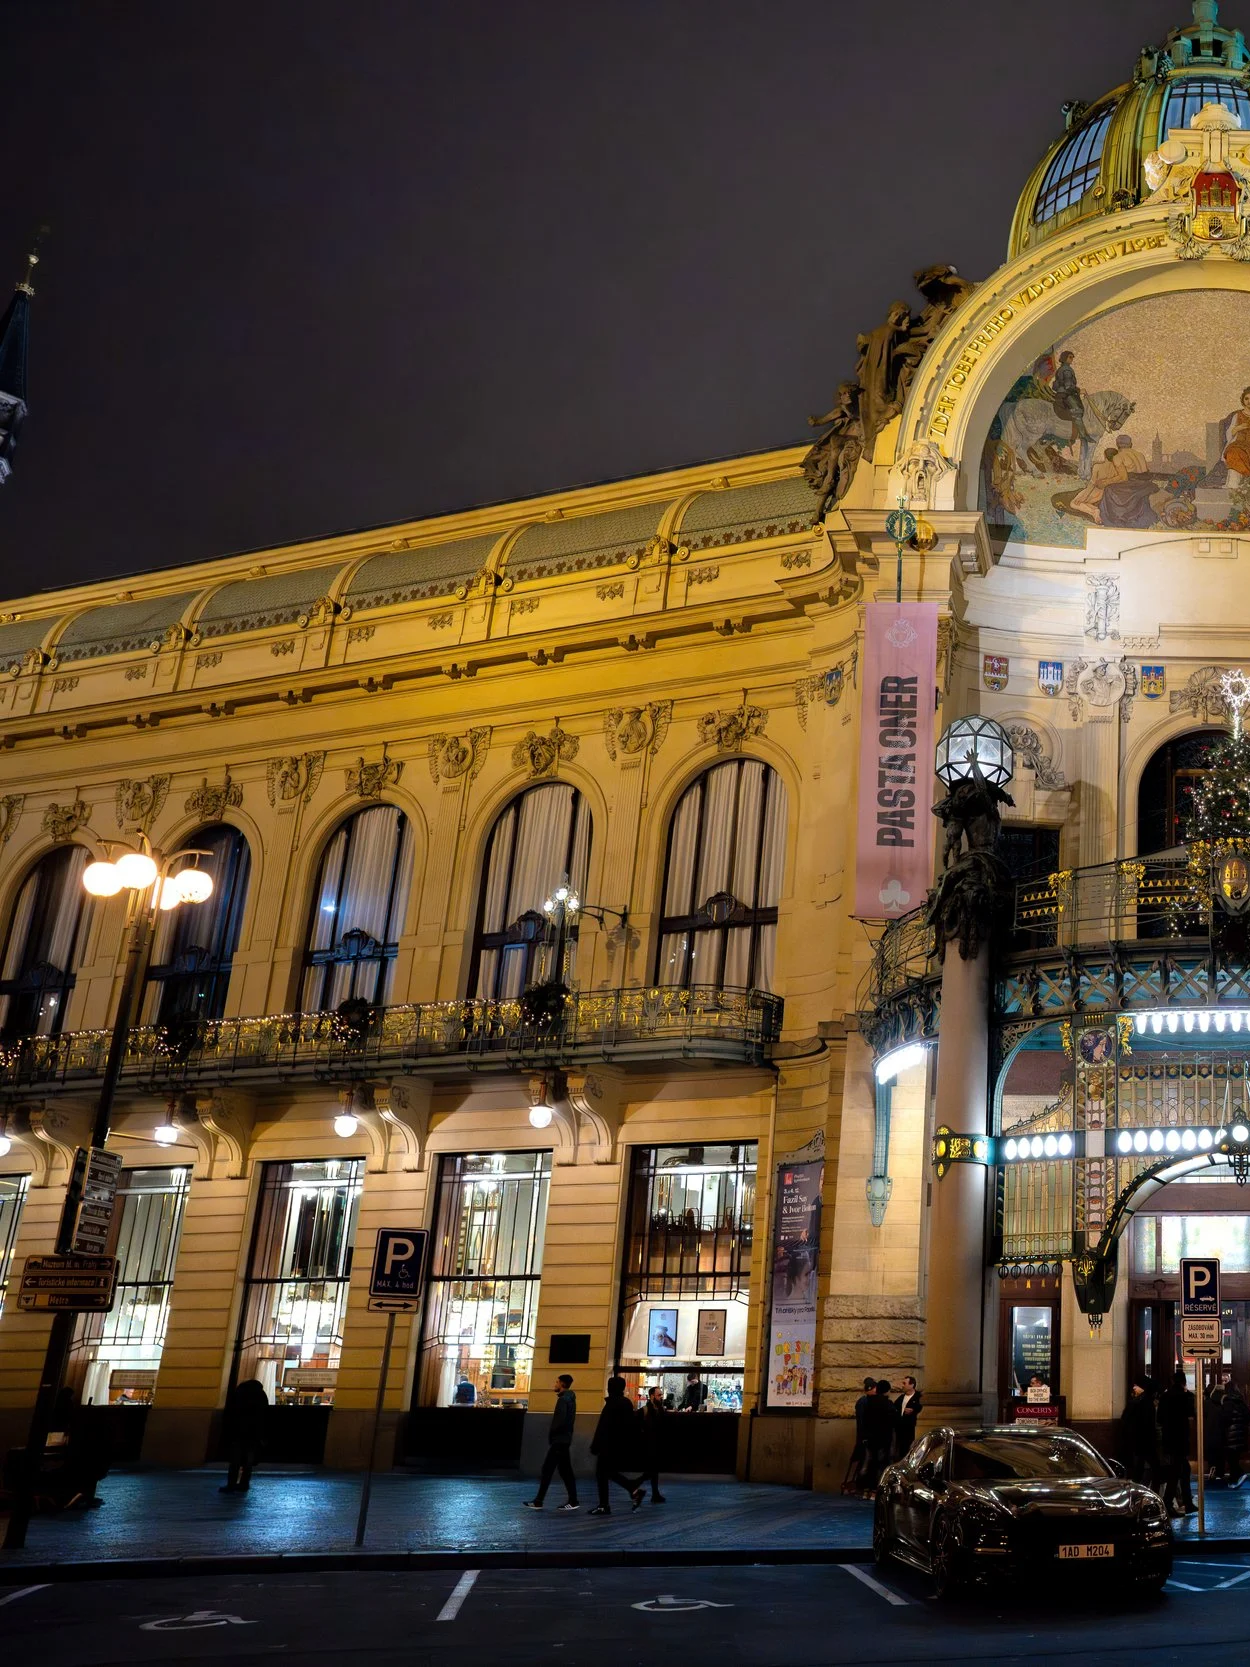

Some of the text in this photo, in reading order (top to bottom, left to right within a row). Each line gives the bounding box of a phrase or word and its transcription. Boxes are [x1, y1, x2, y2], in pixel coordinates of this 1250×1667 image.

[929, 395, 957, 437] ZDAR
[876, 675, 919, 848] PASTA ONER
[384, 1237, 415, 1275] P
[395, 1281, 400, 1289] 4
[1189, 1266, 1211, 1299] P
[1016, 1406, 1052, 1414] CONCERTS
[1062, 1545, 1110, 1558] 1AD M204
